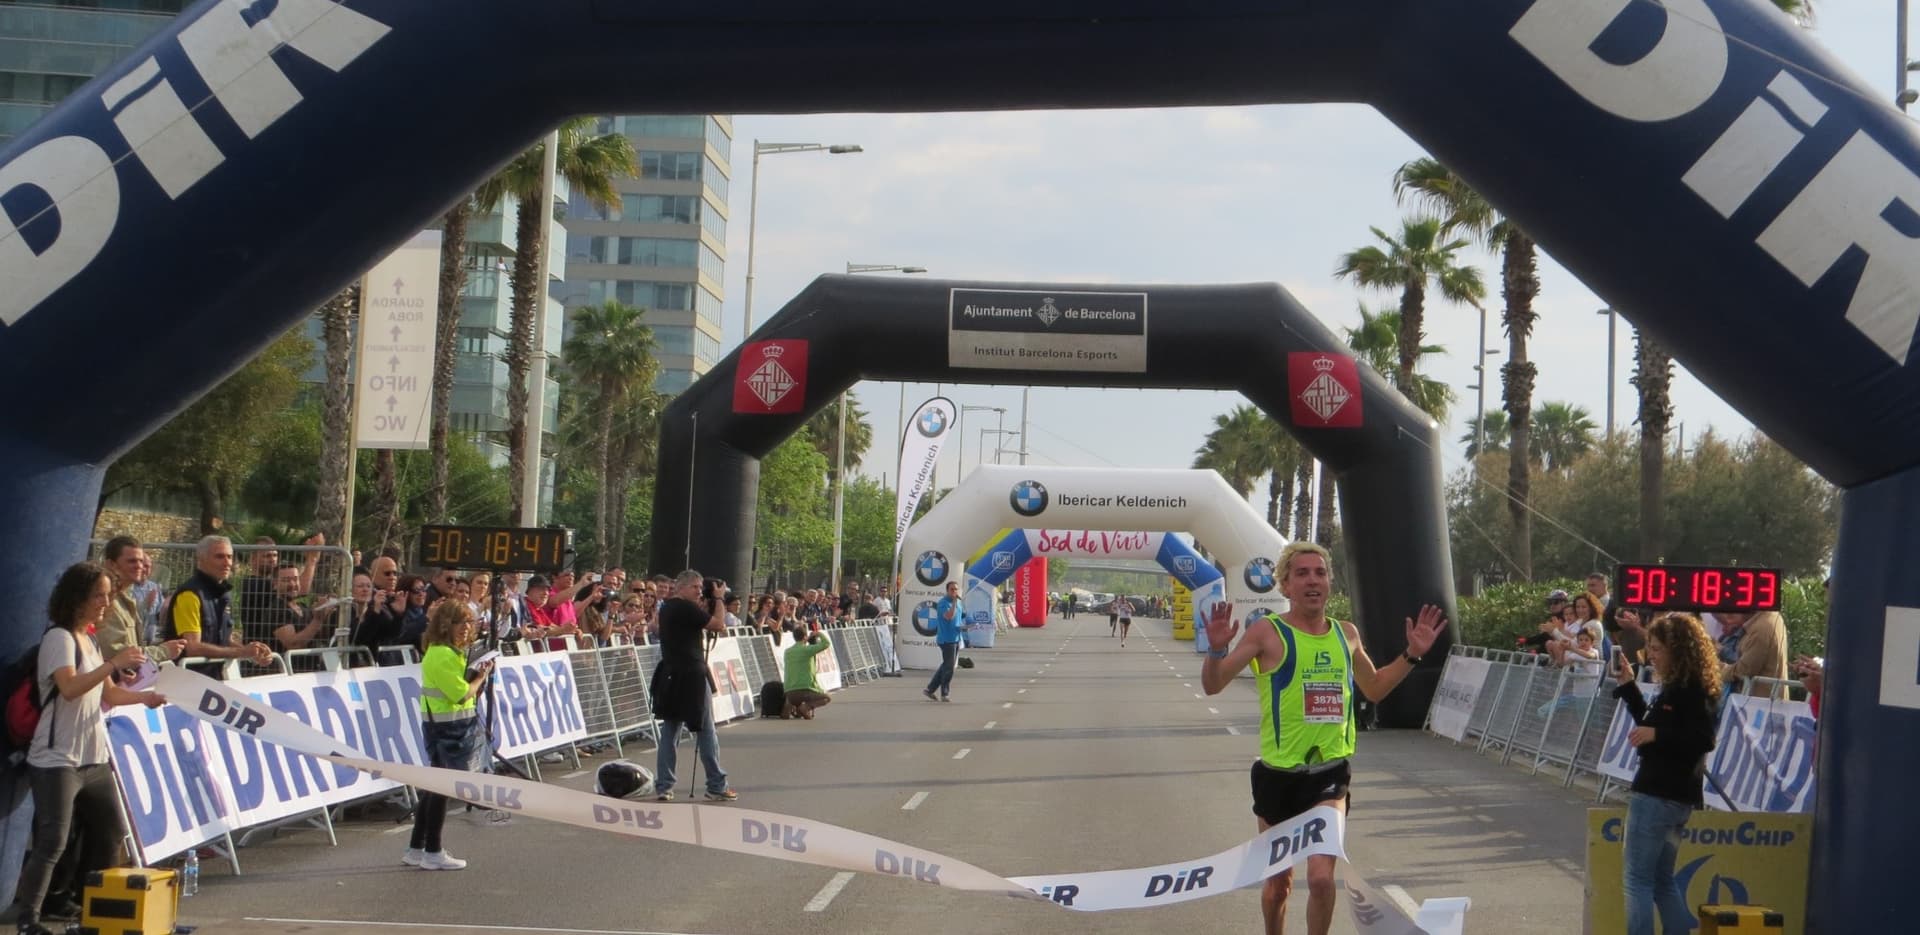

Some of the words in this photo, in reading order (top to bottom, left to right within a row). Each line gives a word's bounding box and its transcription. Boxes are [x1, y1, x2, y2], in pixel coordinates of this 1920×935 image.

[963, 304, 1033, 318] Ajuntament
[1065, 308, 1079, 319] de
[1080, 308, 1136, 321] Barcelona
[974, 346, 1015, 358] Institut
[1019, 348, 1073, 359] Barcelona
[1077, 350, 1118, 361] Esports
[909, 443, 939, 499] Keldenich
[1058, 494, 1112, 507] Ibericar
[1117, 495, 1187, 508] Keldenich
[426, 529, 560, 566] 30:18:41
[1038, 528, 1073, 553] Sed
[1077, 528, 1098, 554] de
[1626, 568, 1776, 607] 30:18:33
[198, 689, 266, 735] DiR
[107, 704, 227, 849] DiR
[1268, 817, 1327, 867] DiR
[1143, 865, 1214, 898] DiR
